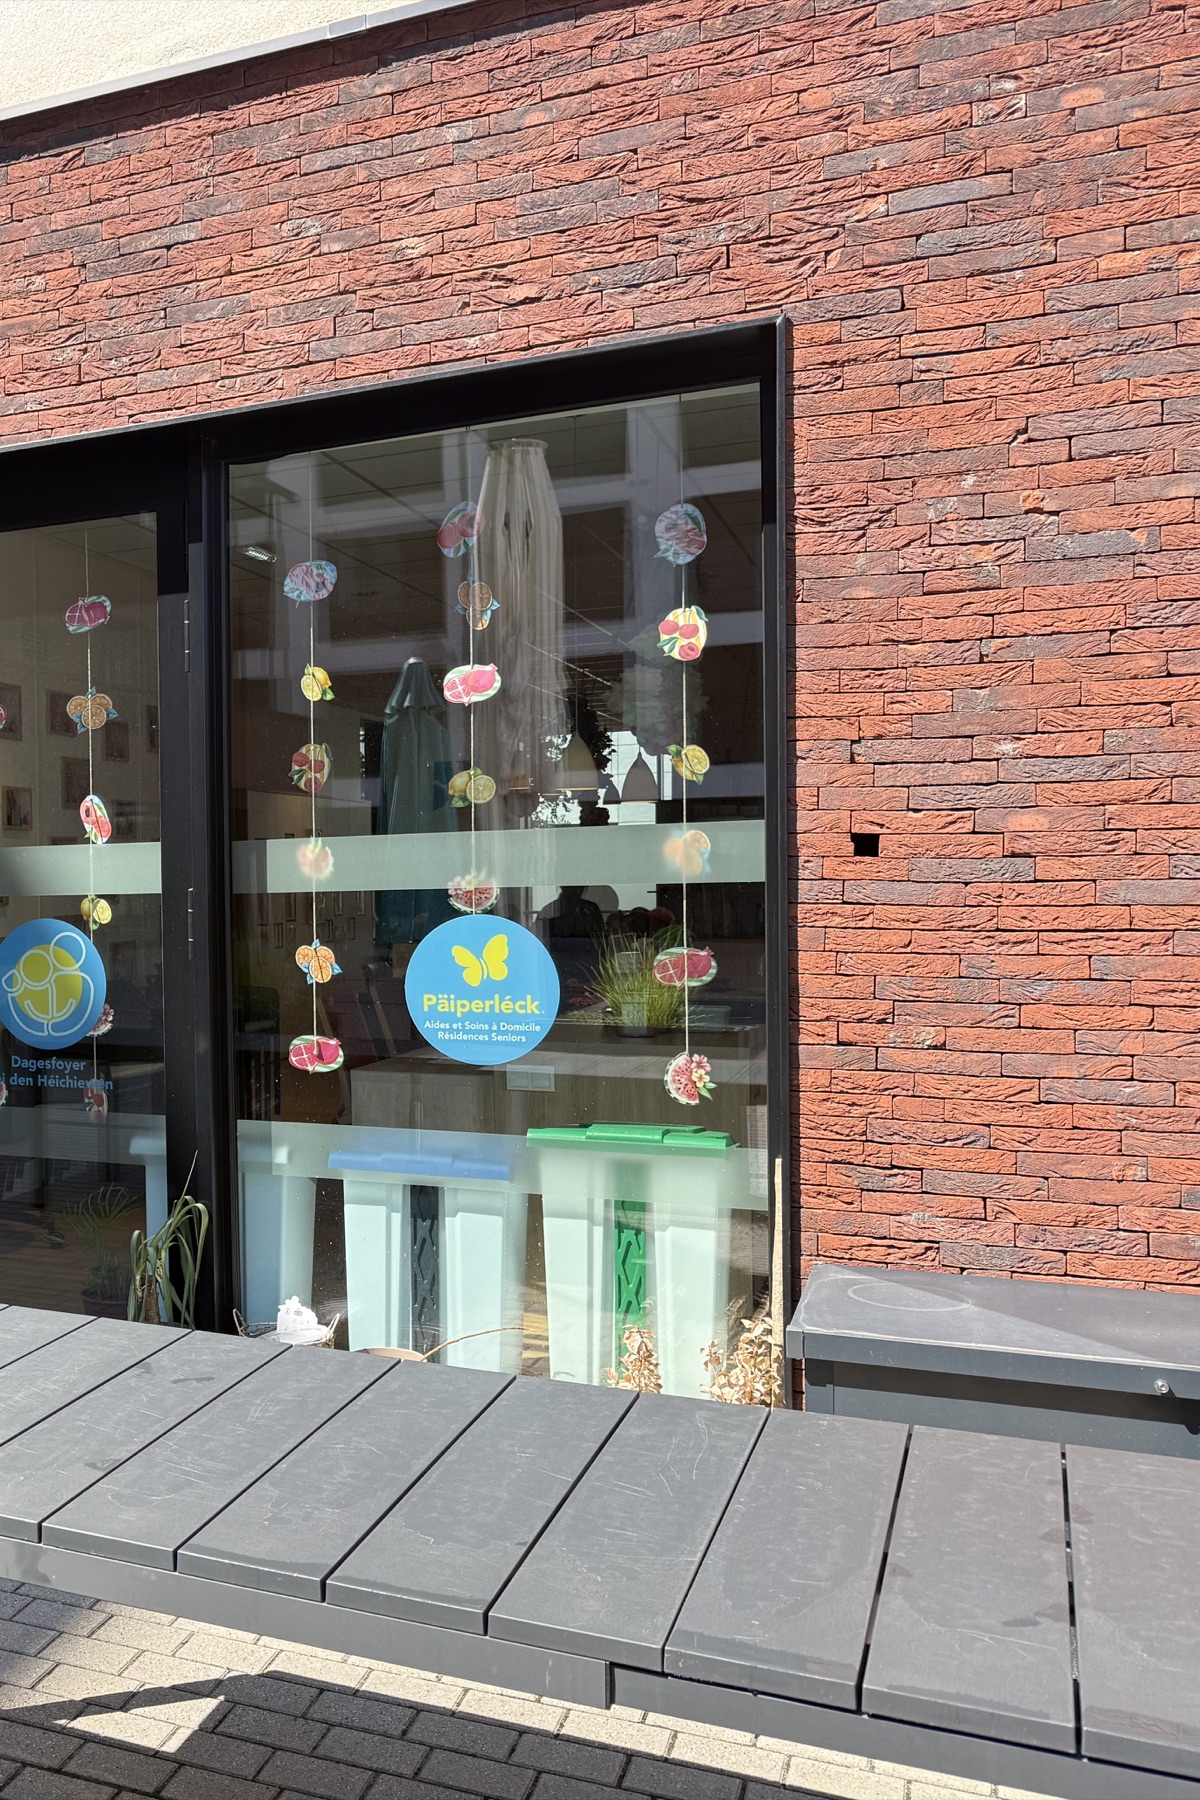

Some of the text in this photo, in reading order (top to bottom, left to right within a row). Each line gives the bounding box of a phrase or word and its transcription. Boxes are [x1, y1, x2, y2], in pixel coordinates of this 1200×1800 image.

[423, 994, 539, 1017] Päiperléck
[424, 1021, 541, 1032] Aides et Soins à Domicile
[438, 1031, 526, 1042] Résidences Seniors
[11, 1056, 86, 1073] Dagesfoyer
[10, 1073, 33, 1086] den
